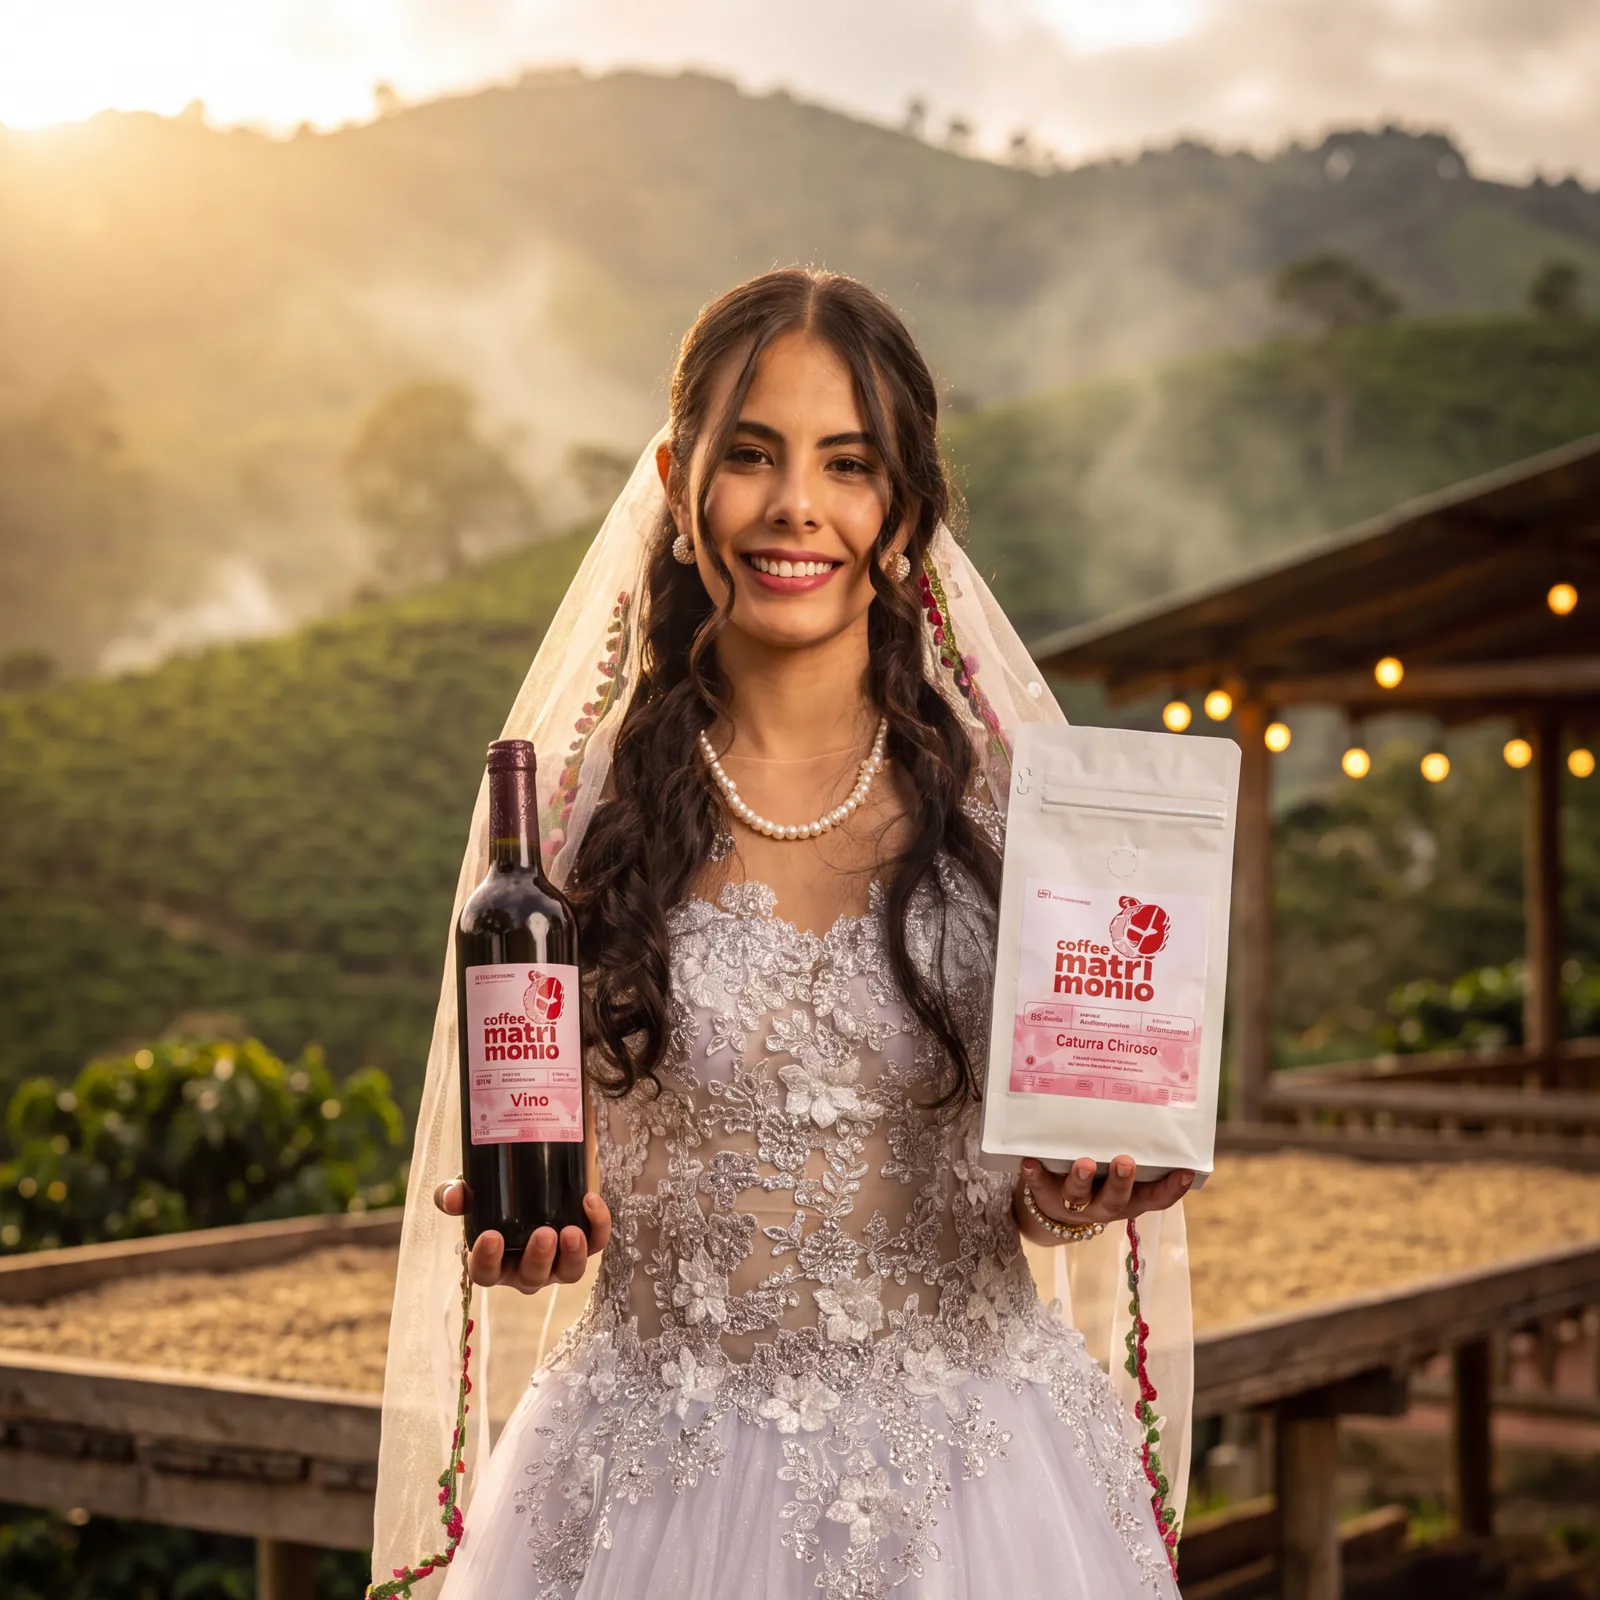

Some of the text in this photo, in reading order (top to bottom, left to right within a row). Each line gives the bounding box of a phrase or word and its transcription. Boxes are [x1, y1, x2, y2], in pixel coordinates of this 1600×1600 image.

[1057, 939, 1110, 956] coffee
[1055, 952, 1153, 981] matri
[1053, 974, 1154, 1002] monio
[484, 1013, 525, 1026] coffee
[484, 1021, 556, 1045] matri
[485, 1043, 560, 1061] monio
[1056, 1034, 1158, 1056] Caturra Chiroso
[510, 1093, 549, 1107] Vino
